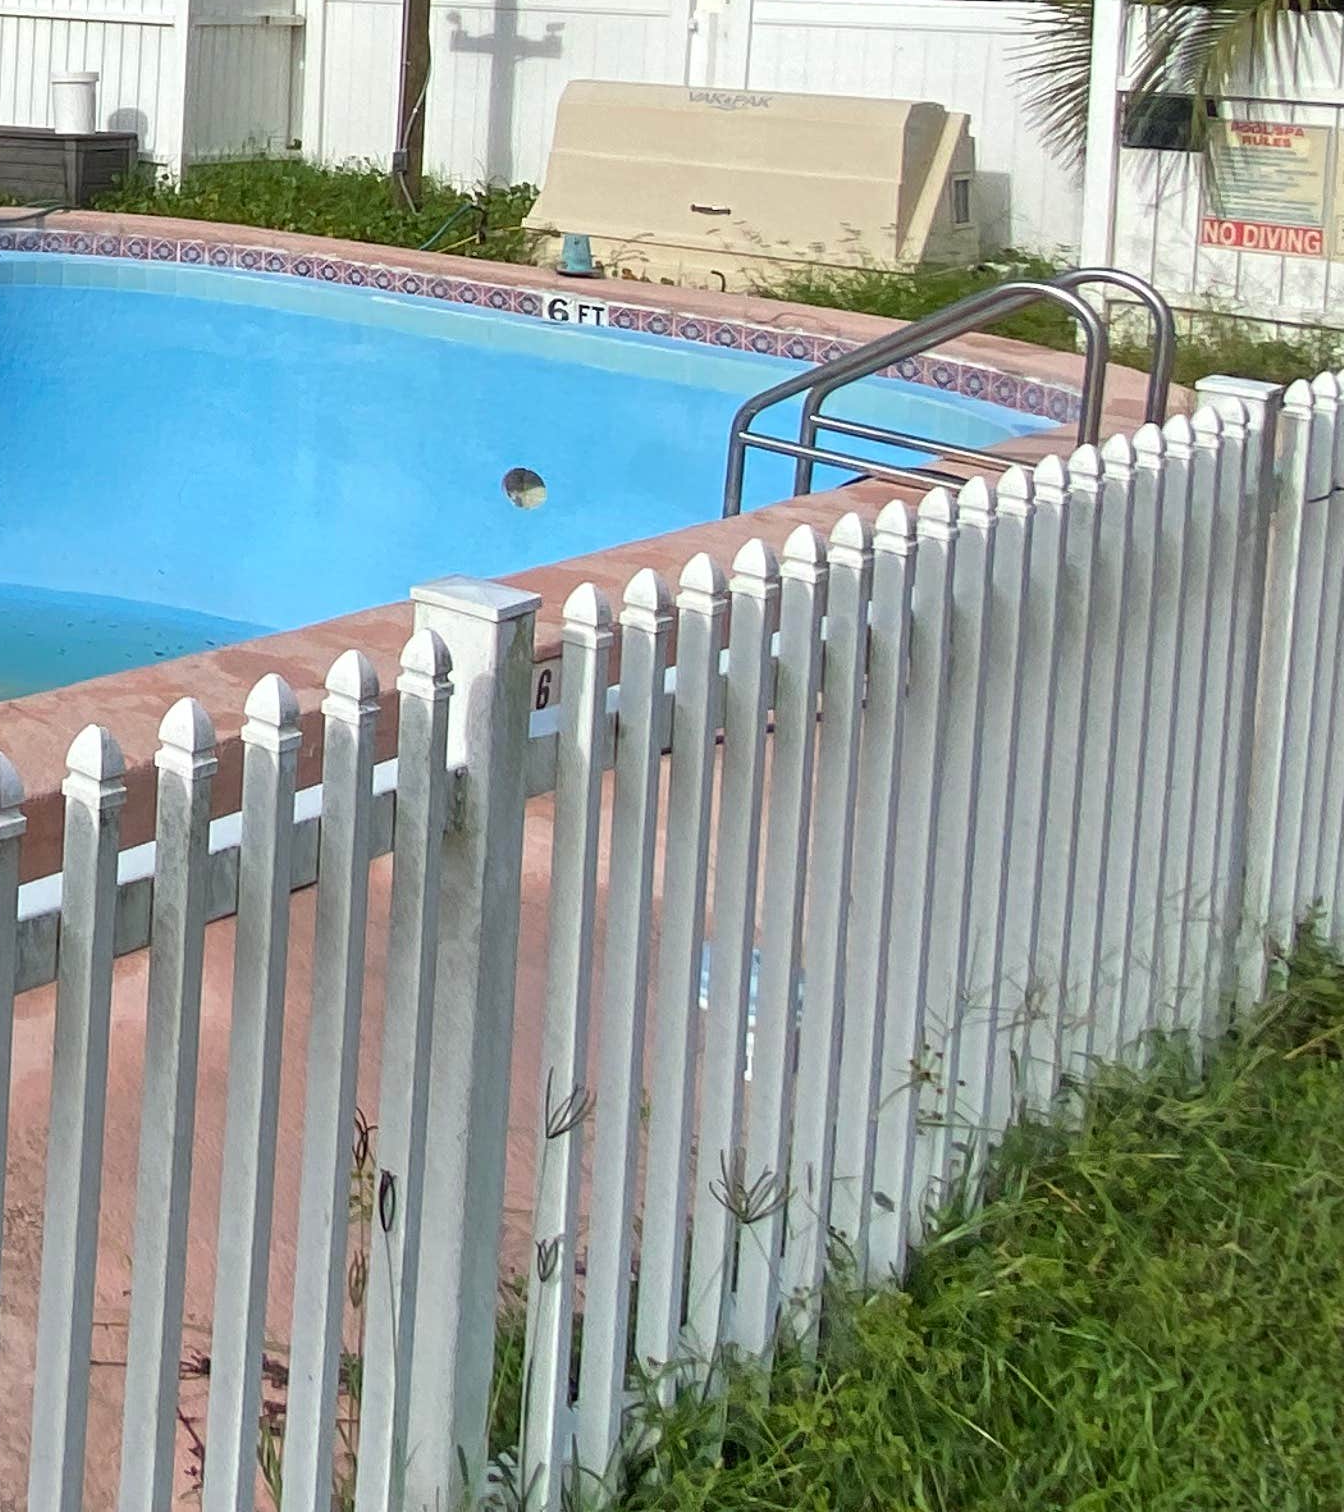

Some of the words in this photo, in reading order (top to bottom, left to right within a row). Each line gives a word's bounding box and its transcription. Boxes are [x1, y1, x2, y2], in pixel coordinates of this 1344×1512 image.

[1203, 220, 1237, 245] NO
[1242, 224, 1322, 254] DIVING
[548, 298, 569, 321] 6
[535, 668, 552, 710] 6
